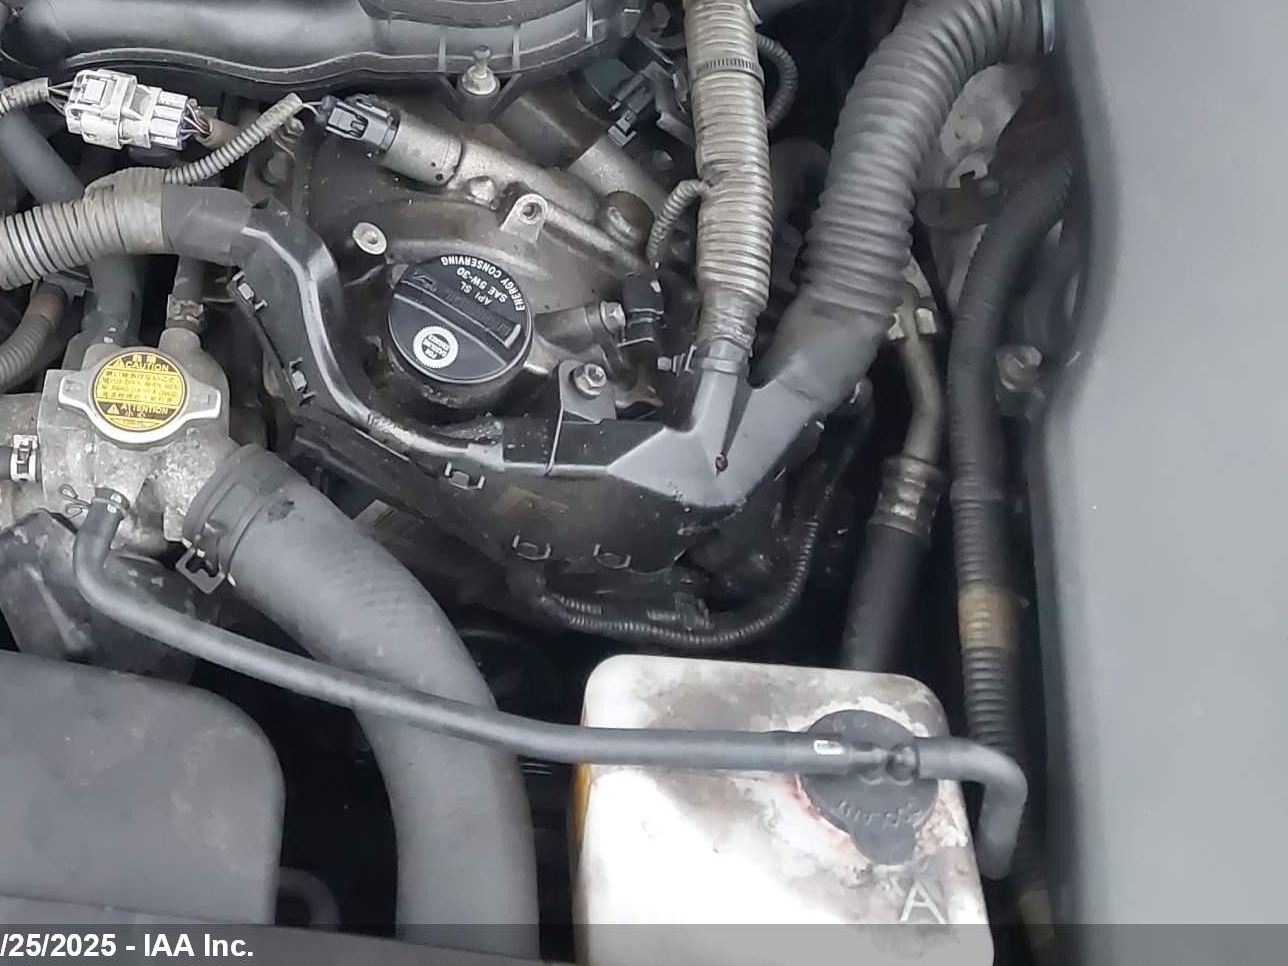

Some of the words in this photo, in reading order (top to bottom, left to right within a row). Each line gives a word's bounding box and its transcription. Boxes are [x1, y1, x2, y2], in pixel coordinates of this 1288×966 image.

[440, 255, 502, 279] CONSERVING
[456, 267, 487, 289] 5W-30
[460, 281, 472, 293] SL
[488, 286, 508, 303] SAE
[500, 277, 526, 311] ENERGY
[474, 291, 493, 305] API
[125, 361, 169, 372] CAUTION
[120, 403, 169, 415] ATTENTION
